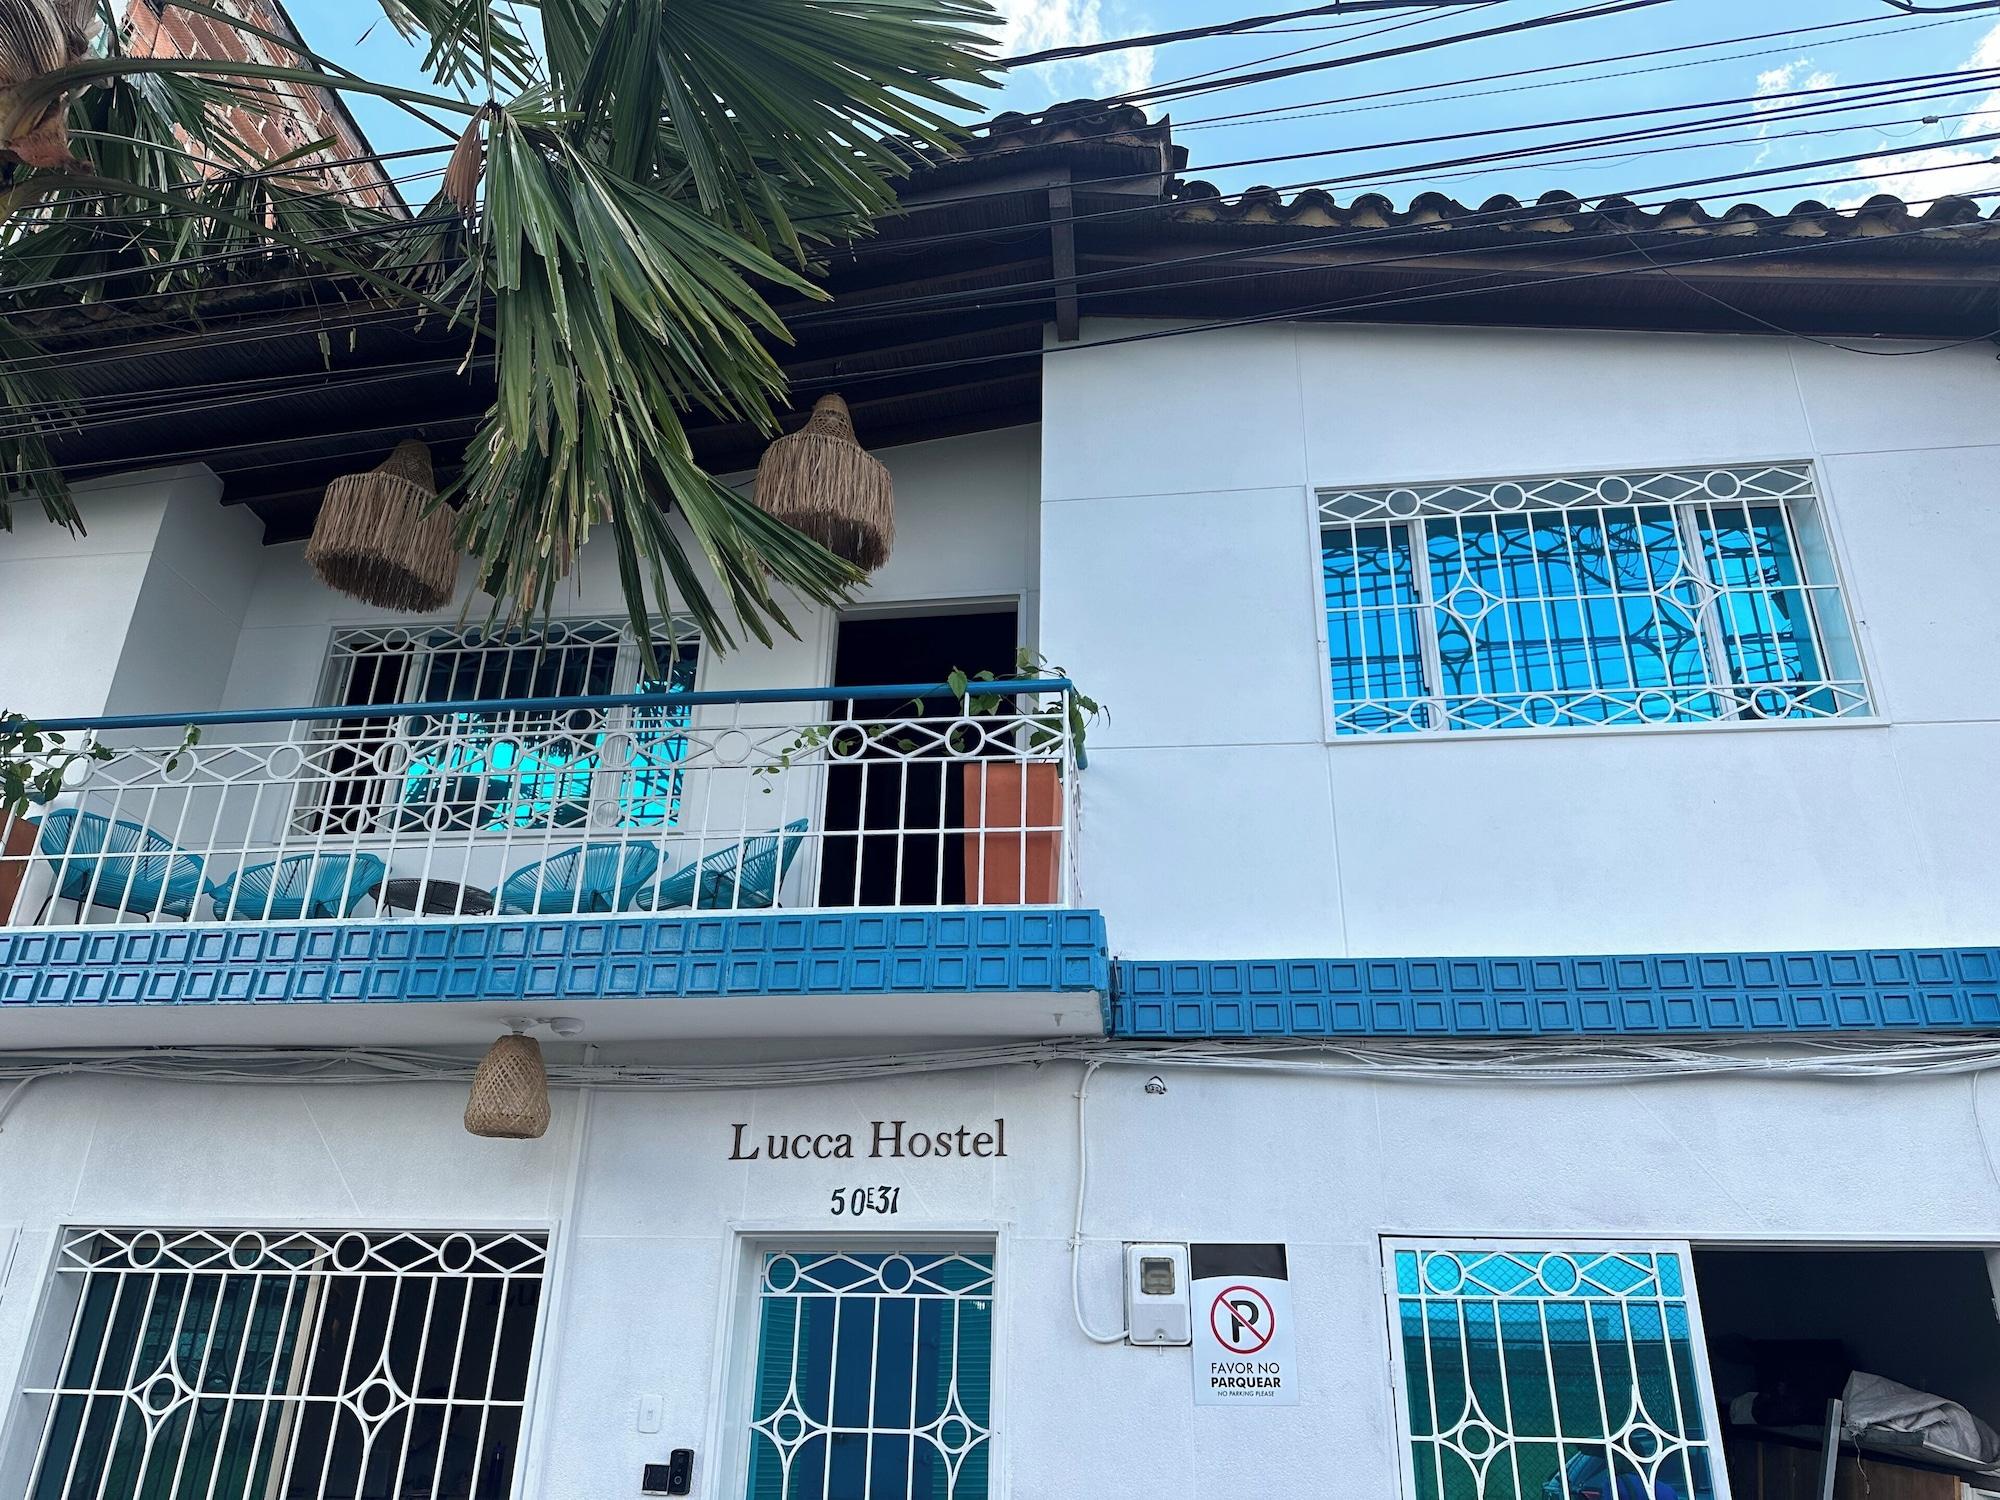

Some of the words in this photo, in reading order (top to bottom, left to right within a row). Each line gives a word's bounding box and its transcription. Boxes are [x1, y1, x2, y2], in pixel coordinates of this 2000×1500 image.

[728, 1123, 854, 1160] Lucca
[868, 1117, 1008, 1158] Hostel
[1211, 1362, 1253, 1374] FAVOR
[1258, 1362, 1280, 1374] NO
[1211, 1377, 1281, 1389] PARQUEAR
